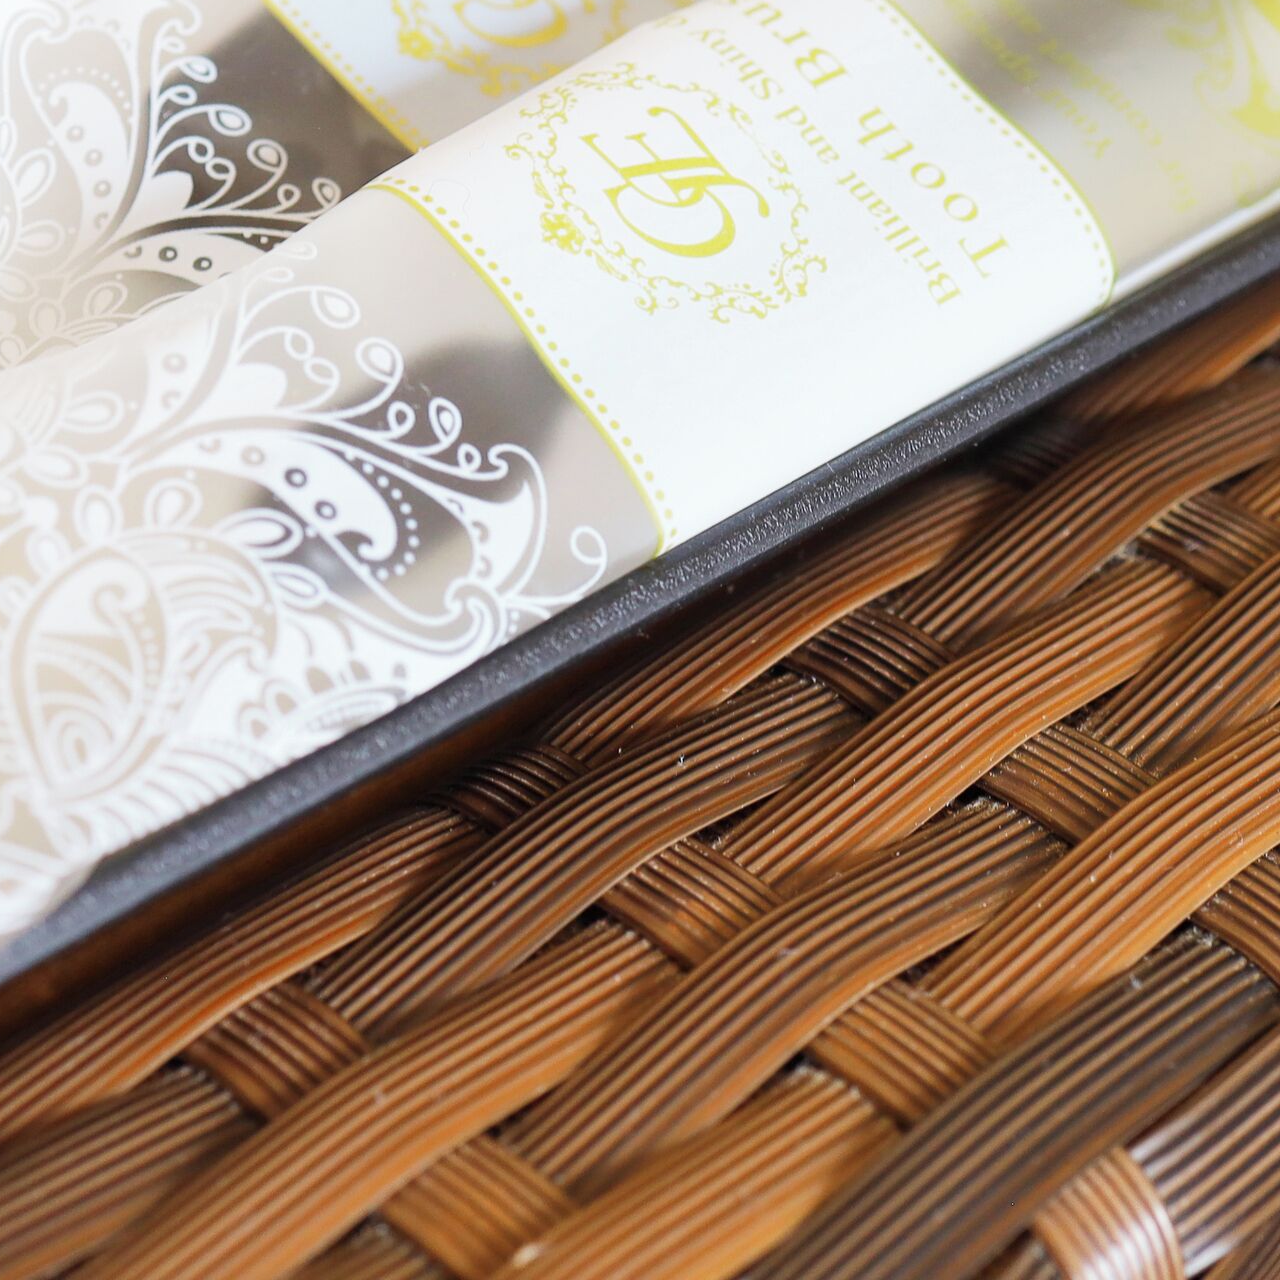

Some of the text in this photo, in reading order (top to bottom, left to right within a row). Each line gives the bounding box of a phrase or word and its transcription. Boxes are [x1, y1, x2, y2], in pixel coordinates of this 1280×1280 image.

[688, 25, 963, 306] Brilliant and Shiny
[856, 106, 1012, 279] Tooth
